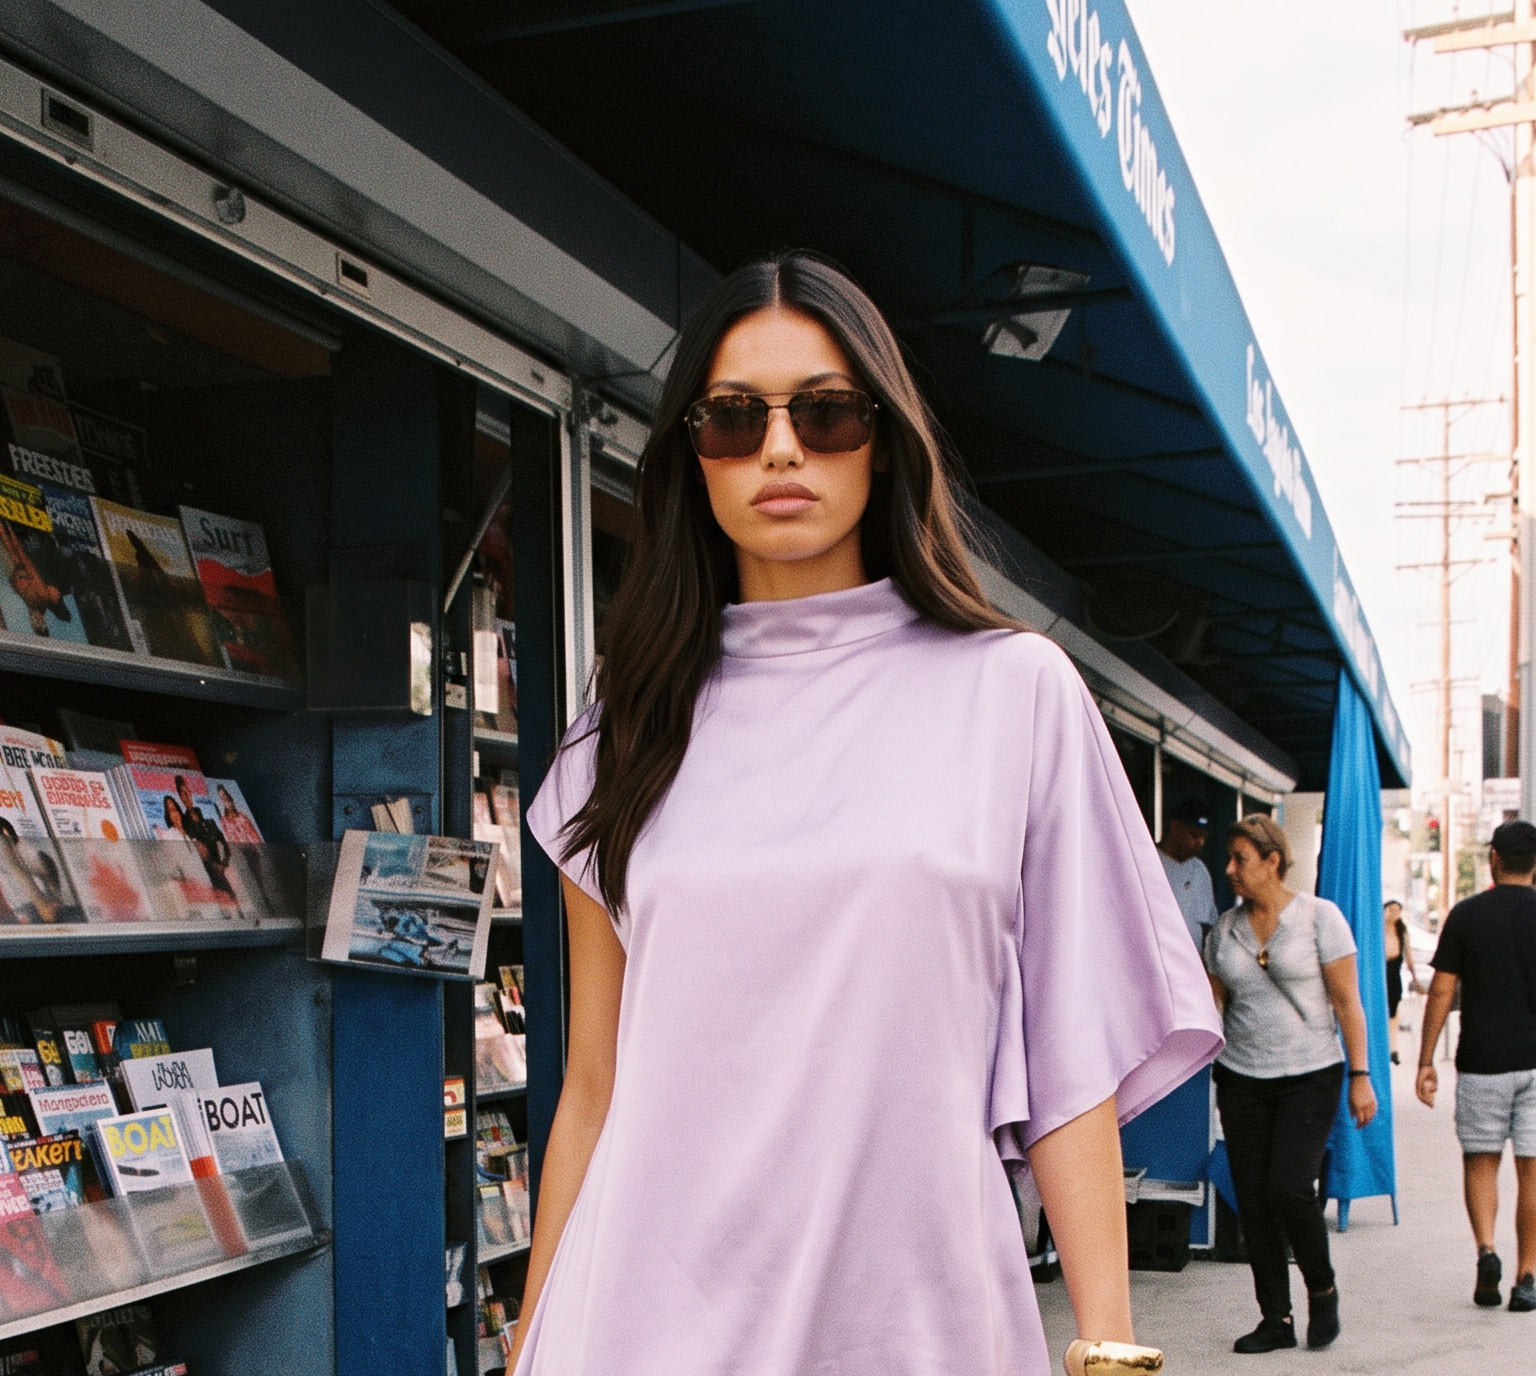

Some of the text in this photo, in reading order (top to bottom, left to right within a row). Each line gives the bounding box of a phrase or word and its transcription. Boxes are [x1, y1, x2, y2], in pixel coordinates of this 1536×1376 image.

[1117, 38, 1175, 268] Times
[204, 1092, 267, 1132] BOAT
[103, 1115, 177, 1158] BOAT
